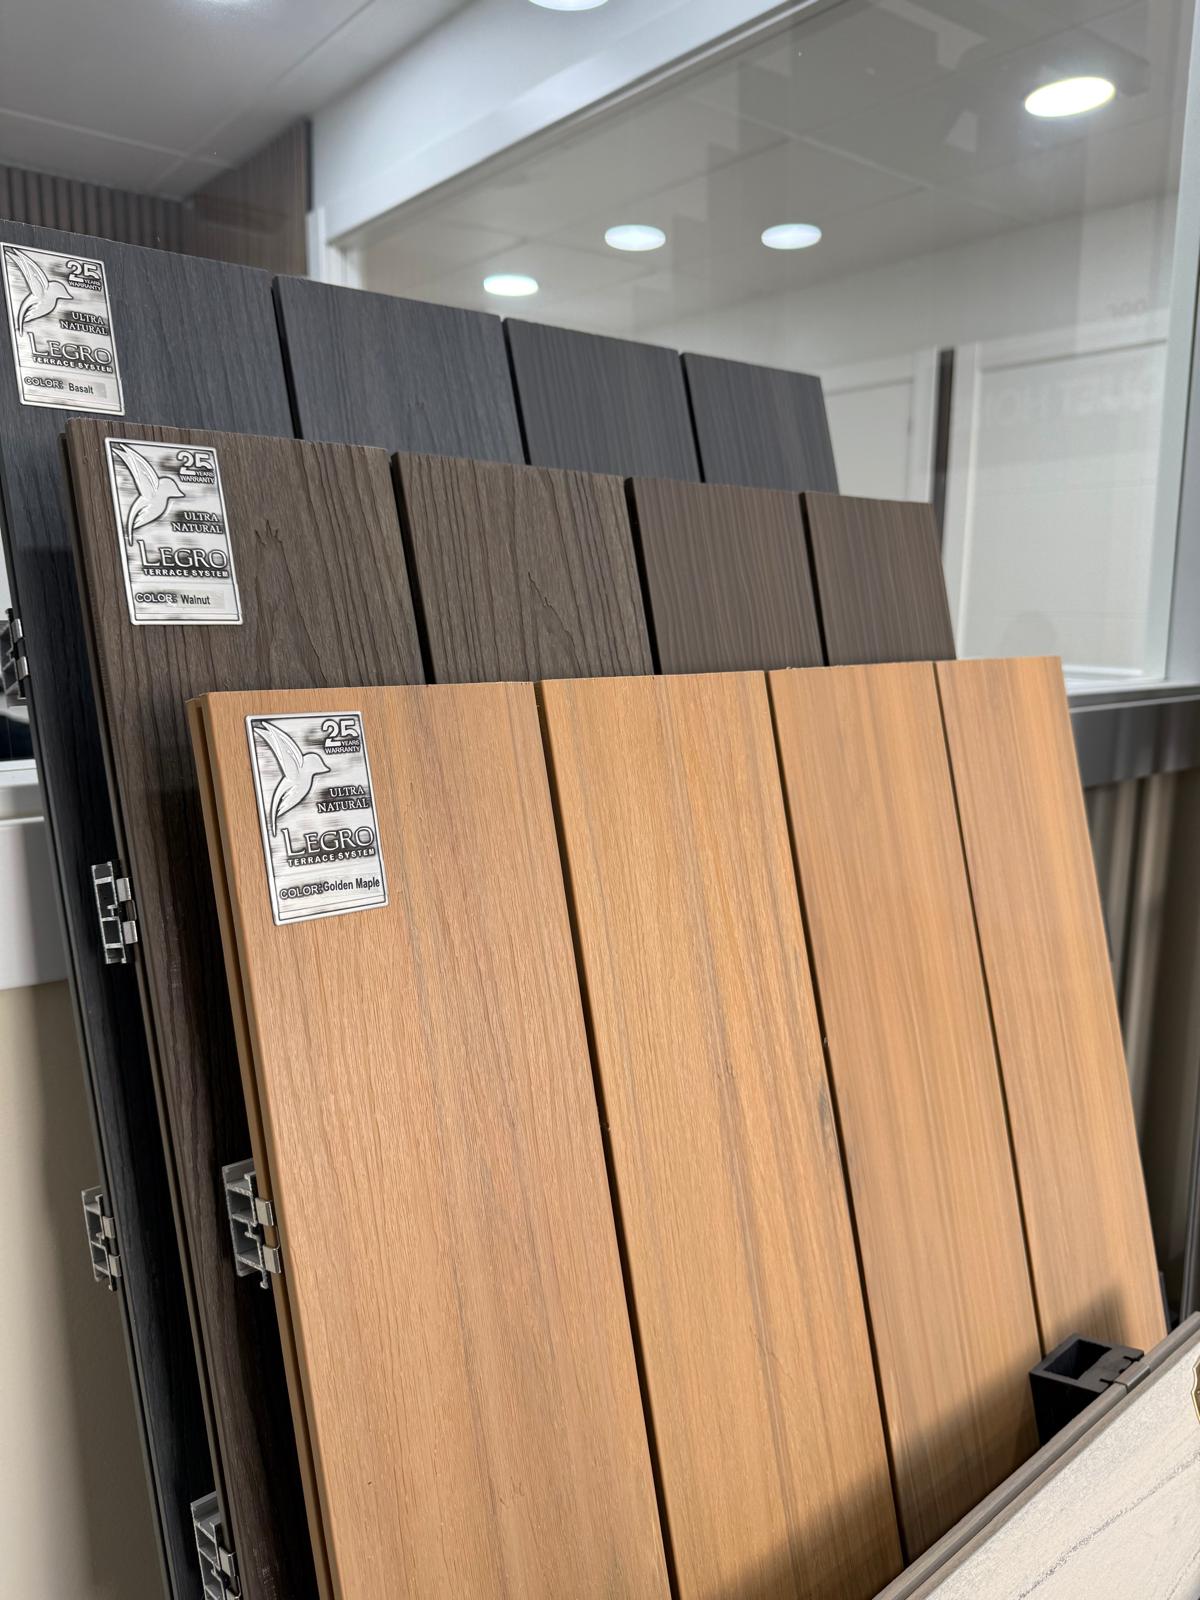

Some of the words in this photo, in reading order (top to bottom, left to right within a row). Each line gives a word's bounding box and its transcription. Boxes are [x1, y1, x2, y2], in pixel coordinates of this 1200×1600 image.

[66, 260, 100, 283] 25
[68, 280, 102, 291] WARRANTY
[71, 311, 104, 325] ULTRA
[59, 320, 109, 336] NATURAL
[27, 332, 113, 365] LEGRO
[32, 356, 77, 369] TERRACE
[78, 362, 113, 374] SYSTEM
[24, 376, 64, 389] COLOR:
[68, 383, 94, 394] Basalt
[176, 450, 214, 475] 25
[180, 475, 215, 484] WARRANTY
[183, 511, 219, 522] ULTRA
[172, 522, 224, 534] NATURAL
[137, 540, 228, 569] LEGRO
[143, 568, 189, 577] TERRACE
[192, 569, 230, 578] SYSTEM
[135, 592, 178, 604] COLOR:
[181, 594, 211, 605] Walnut
[321, 718, 360, 746] 25
[324, 745, 361, 755] WARRANTY
[329, 786, 365, 798] ULTRA
[317, 798, 370, 813] NATURAL
[281, 826, 375, 856] LEGRO
[287, 853, 335, 867] TERRACE
[338, 848, 376, 861] SYSTEM
[323, 878, 354, 892] Golden
[355, 876, 380, 889] Maple
